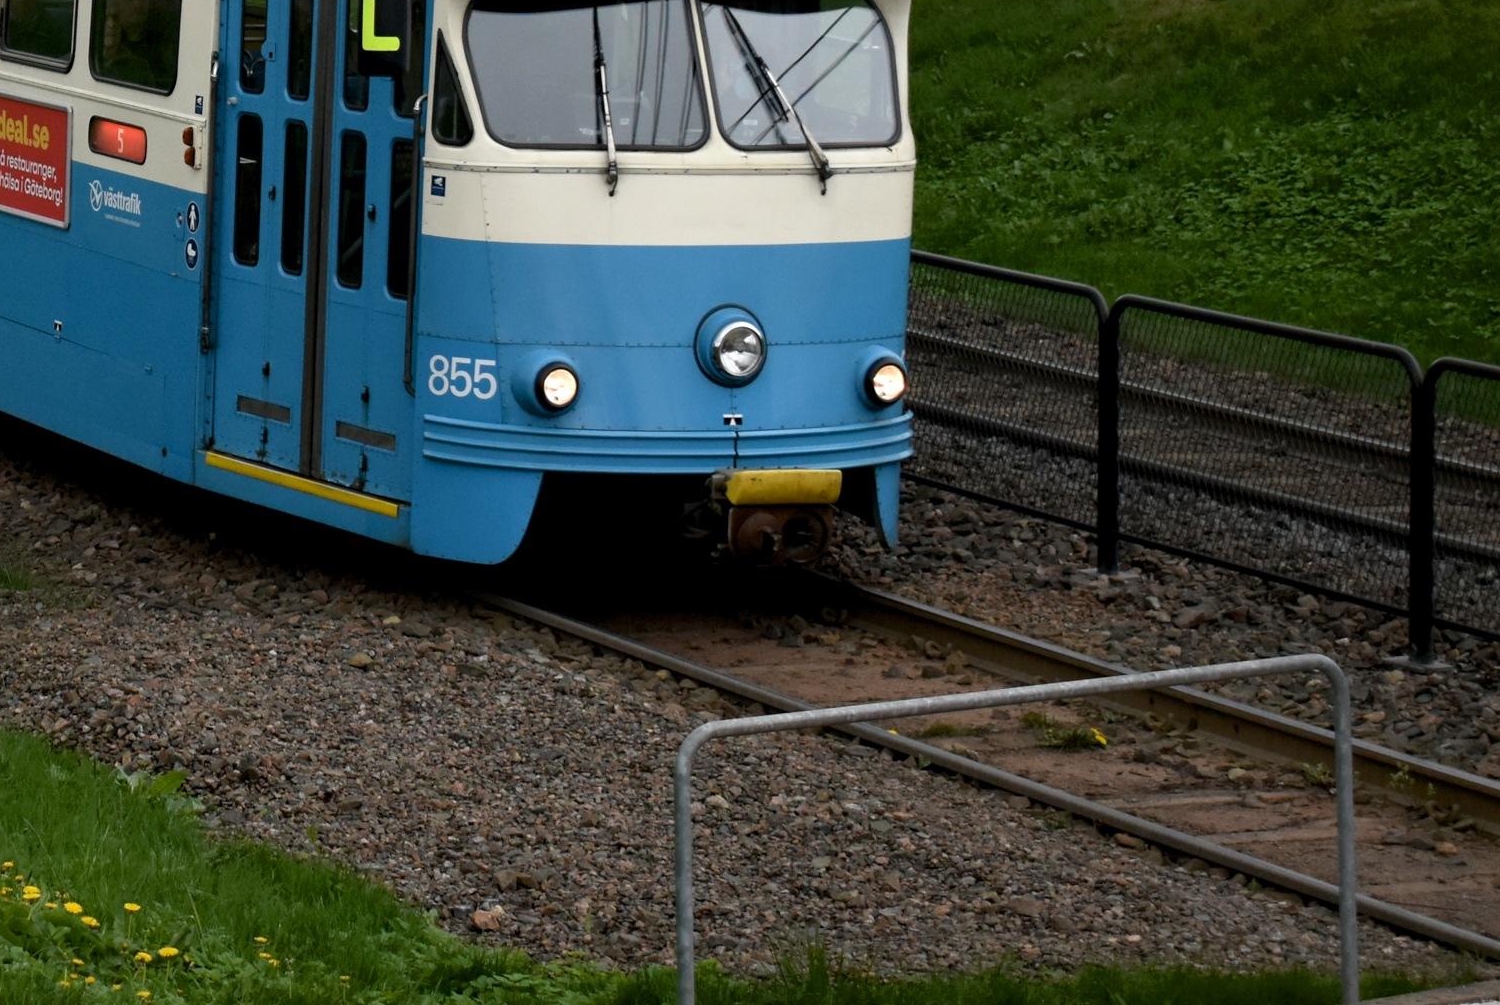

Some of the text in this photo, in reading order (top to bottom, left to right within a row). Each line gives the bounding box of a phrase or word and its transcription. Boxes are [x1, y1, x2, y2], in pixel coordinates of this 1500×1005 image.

[117, 128, 124, 153] 5
[6, 155, 57, 183] restauranger,
[0, 171, 20, 191] hälsa
[24, 176, 63, 206] Göteborg!
[103, 187, 141, 215] västtrafik
[428, 354, 498, 400] 855
